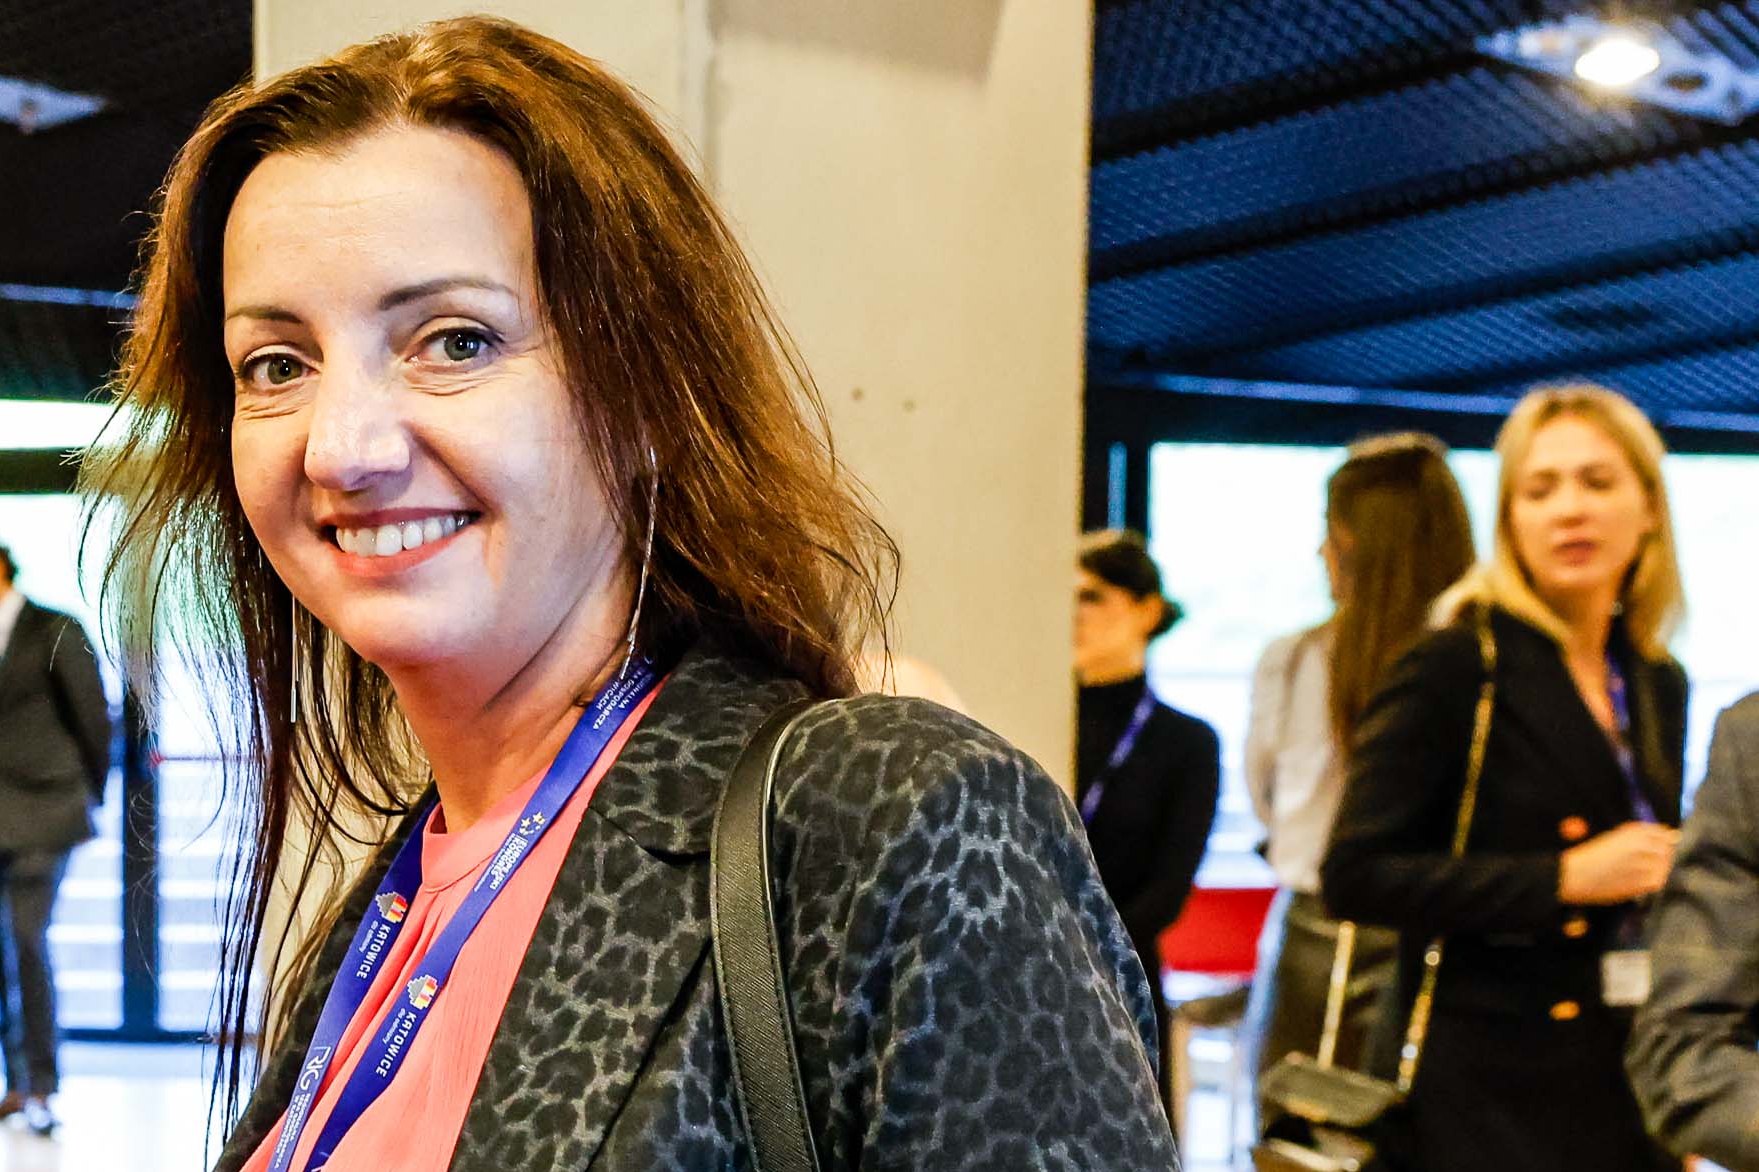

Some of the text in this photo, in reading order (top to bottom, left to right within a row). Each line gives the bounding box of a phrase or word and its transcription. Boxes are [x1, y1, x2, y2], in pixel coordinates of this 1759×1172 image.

[595, 680, 620, 710] WICACH
[489, 838, 529, 890] EUROPEJSKI
[356, 923, 391, 980] KATOWICE
[375, 1011, 417, 1078] KATOWICE
